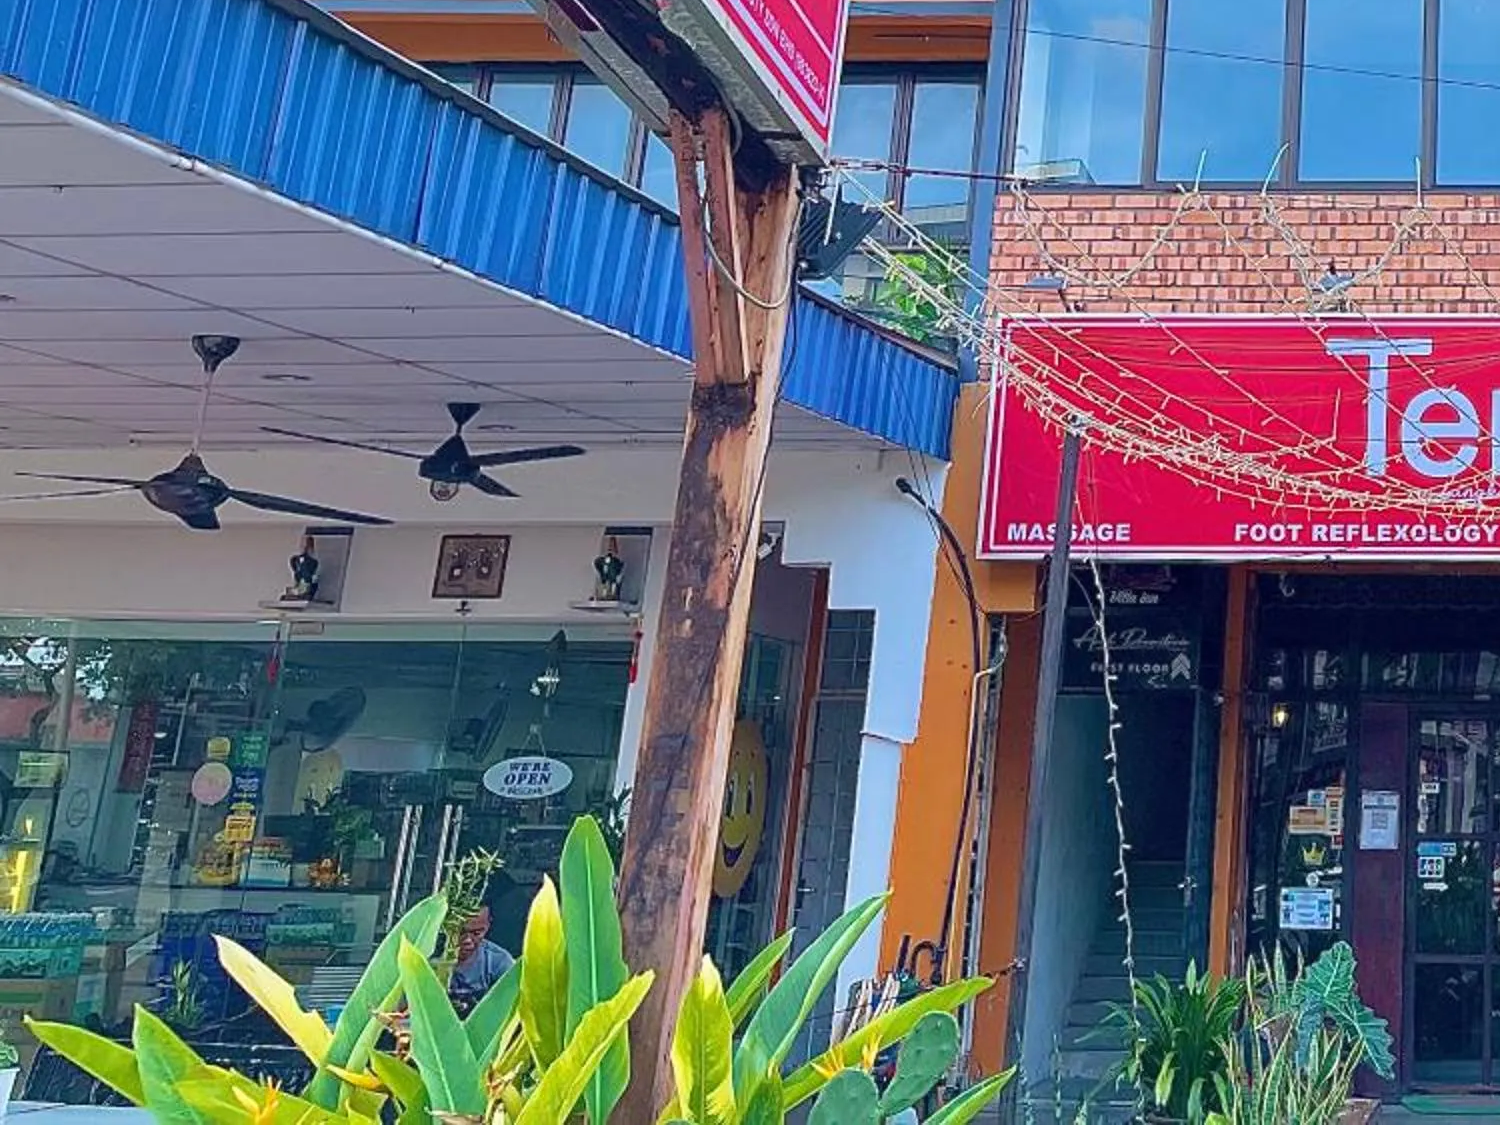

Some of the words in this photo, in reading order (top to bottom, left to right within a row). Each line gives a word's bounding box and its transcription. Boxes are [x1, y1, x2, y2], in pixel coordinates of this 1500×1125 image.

[1233, 523, 1303, 543] FOOT
[1311, 523, 1500, 544] REFLEXOLOGY
[503, 773, 553, 785] OPEN
